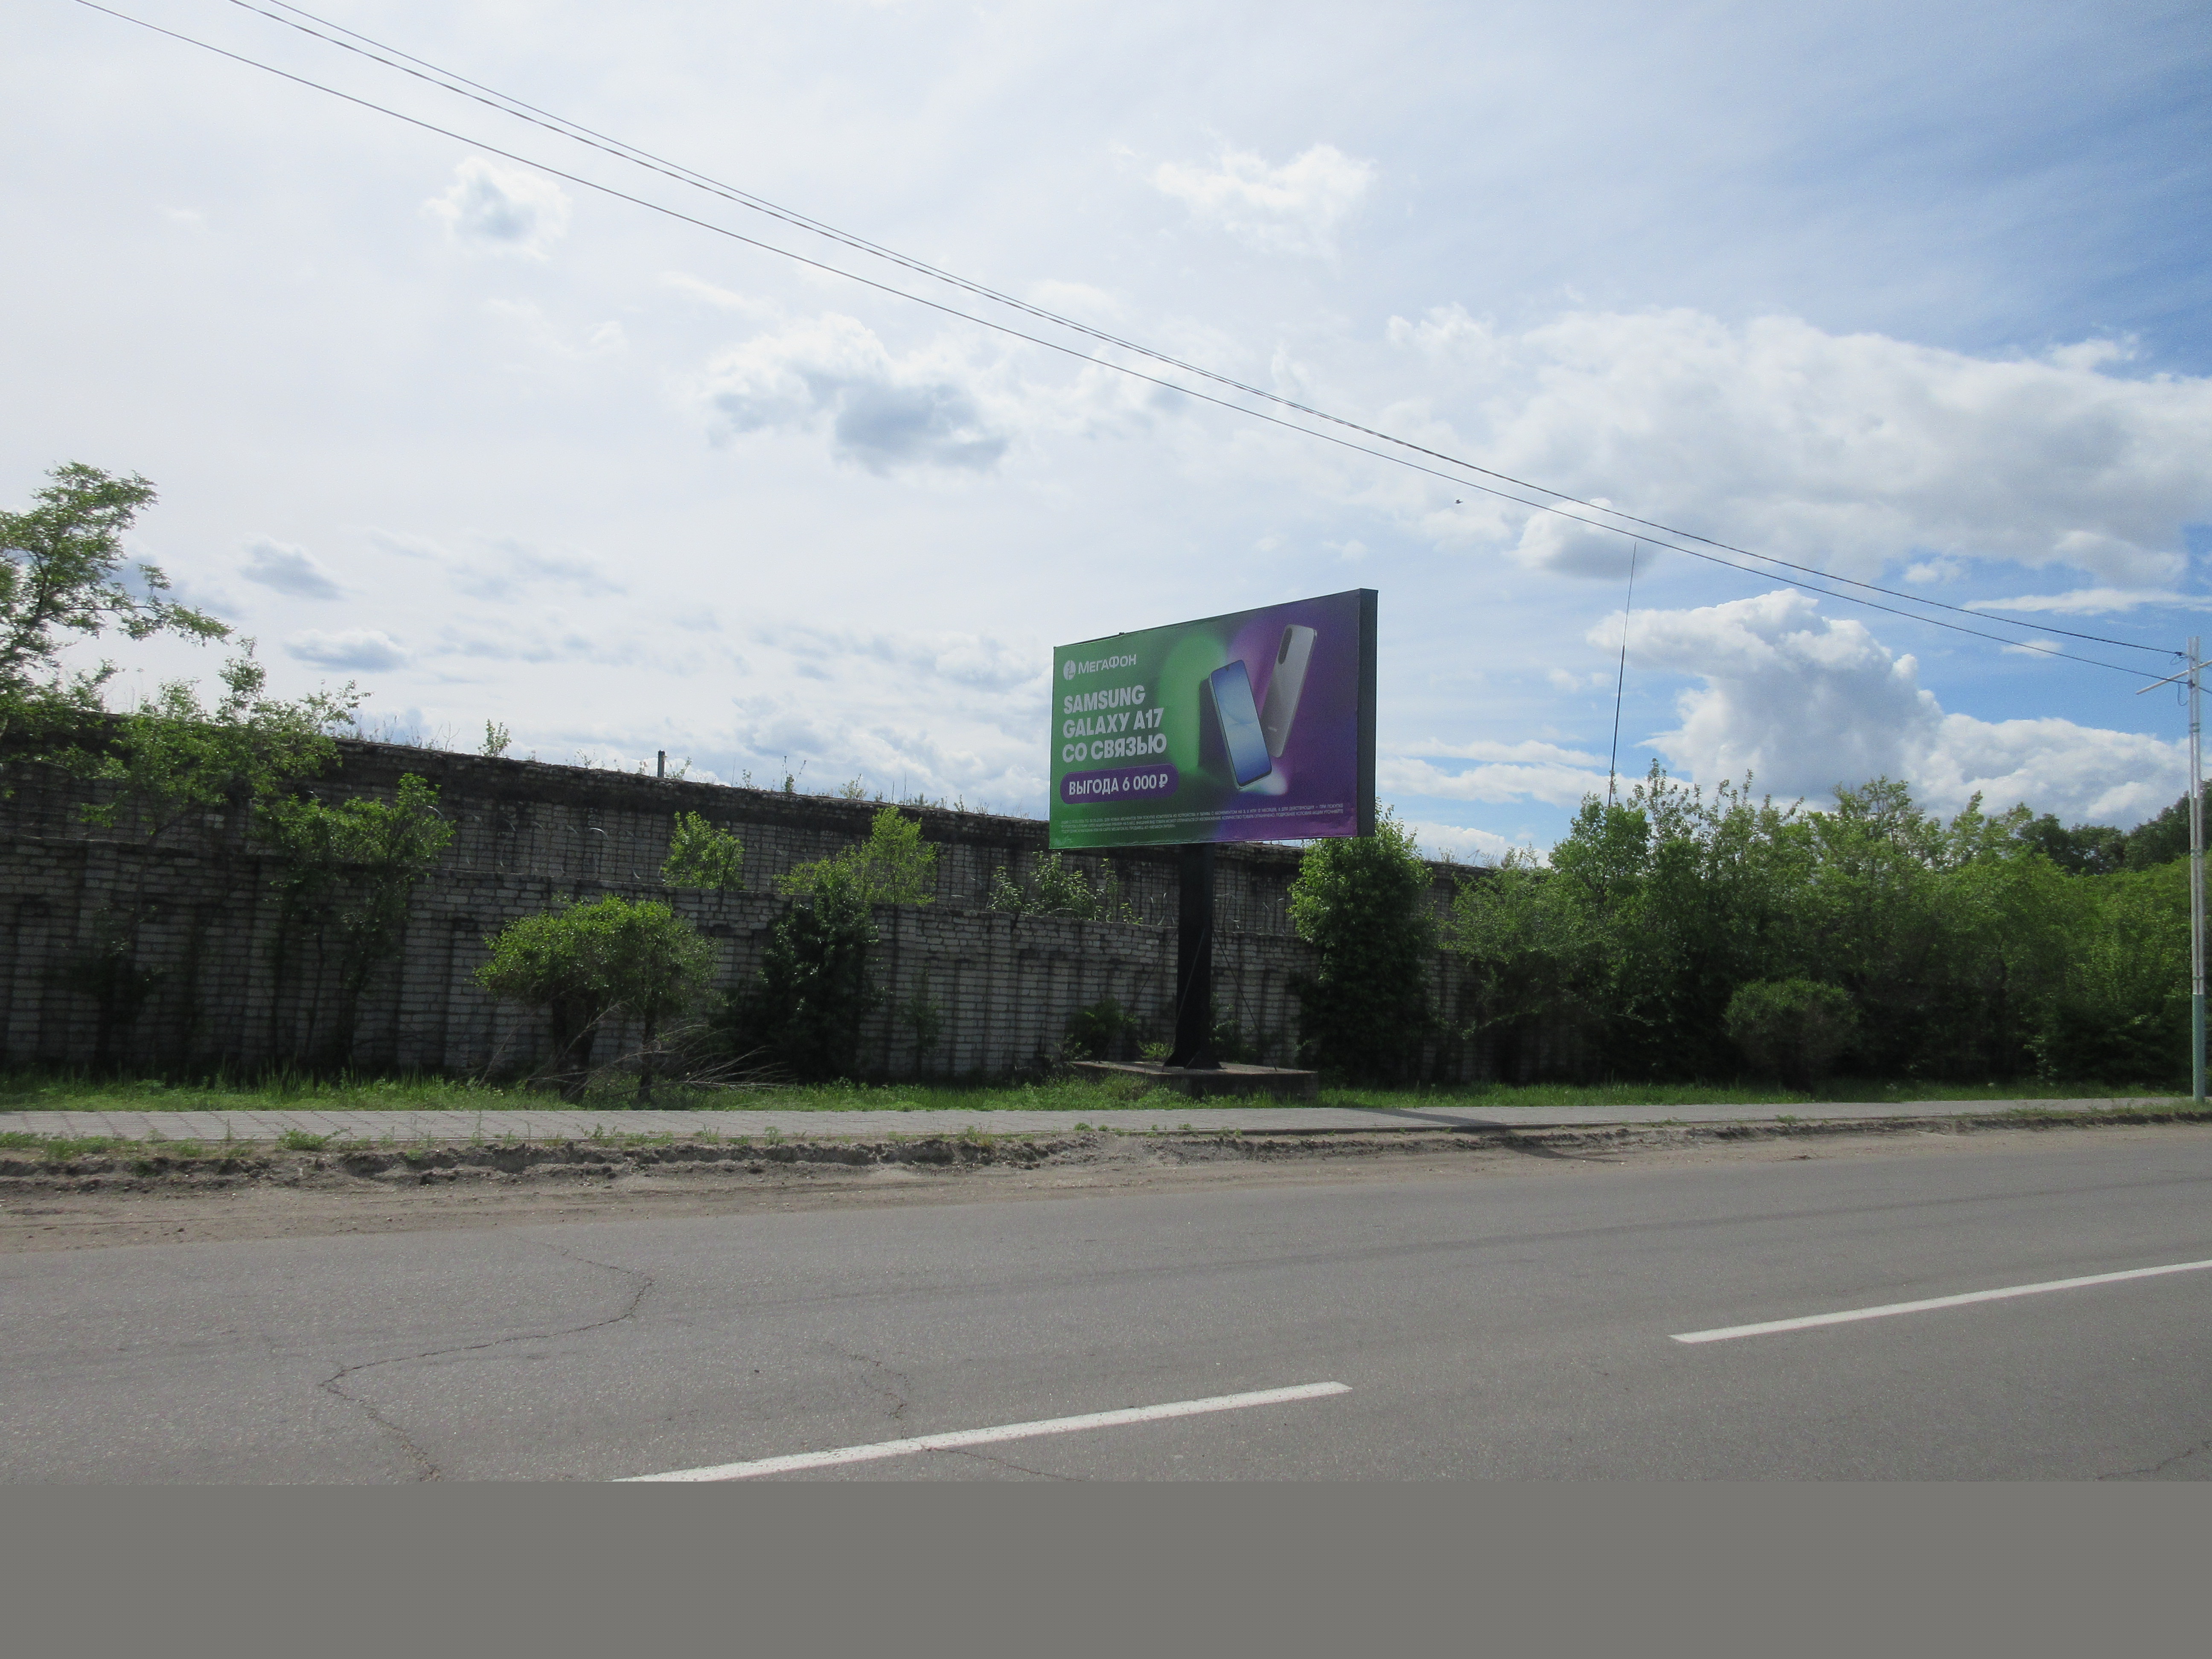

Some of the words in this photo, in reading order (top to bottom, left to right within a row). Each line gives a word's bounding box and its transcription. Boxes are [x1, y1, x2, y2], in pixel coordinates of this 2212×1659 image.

[1064, 685, 1146, 714] SAMSUNG
[1063, 712, 1130, 738] GALAXY
[1133, 707, 1164, 730] A17
[1062, 742, 1087, 763] СО
[1091, 733, 1167, 760] СВЯЗЬЮ
[1069, 778, 1119, 795] ВЫГОДА
[1122, 777, 1130, 791] 6
[1133, 774, 1157, 790] 000
